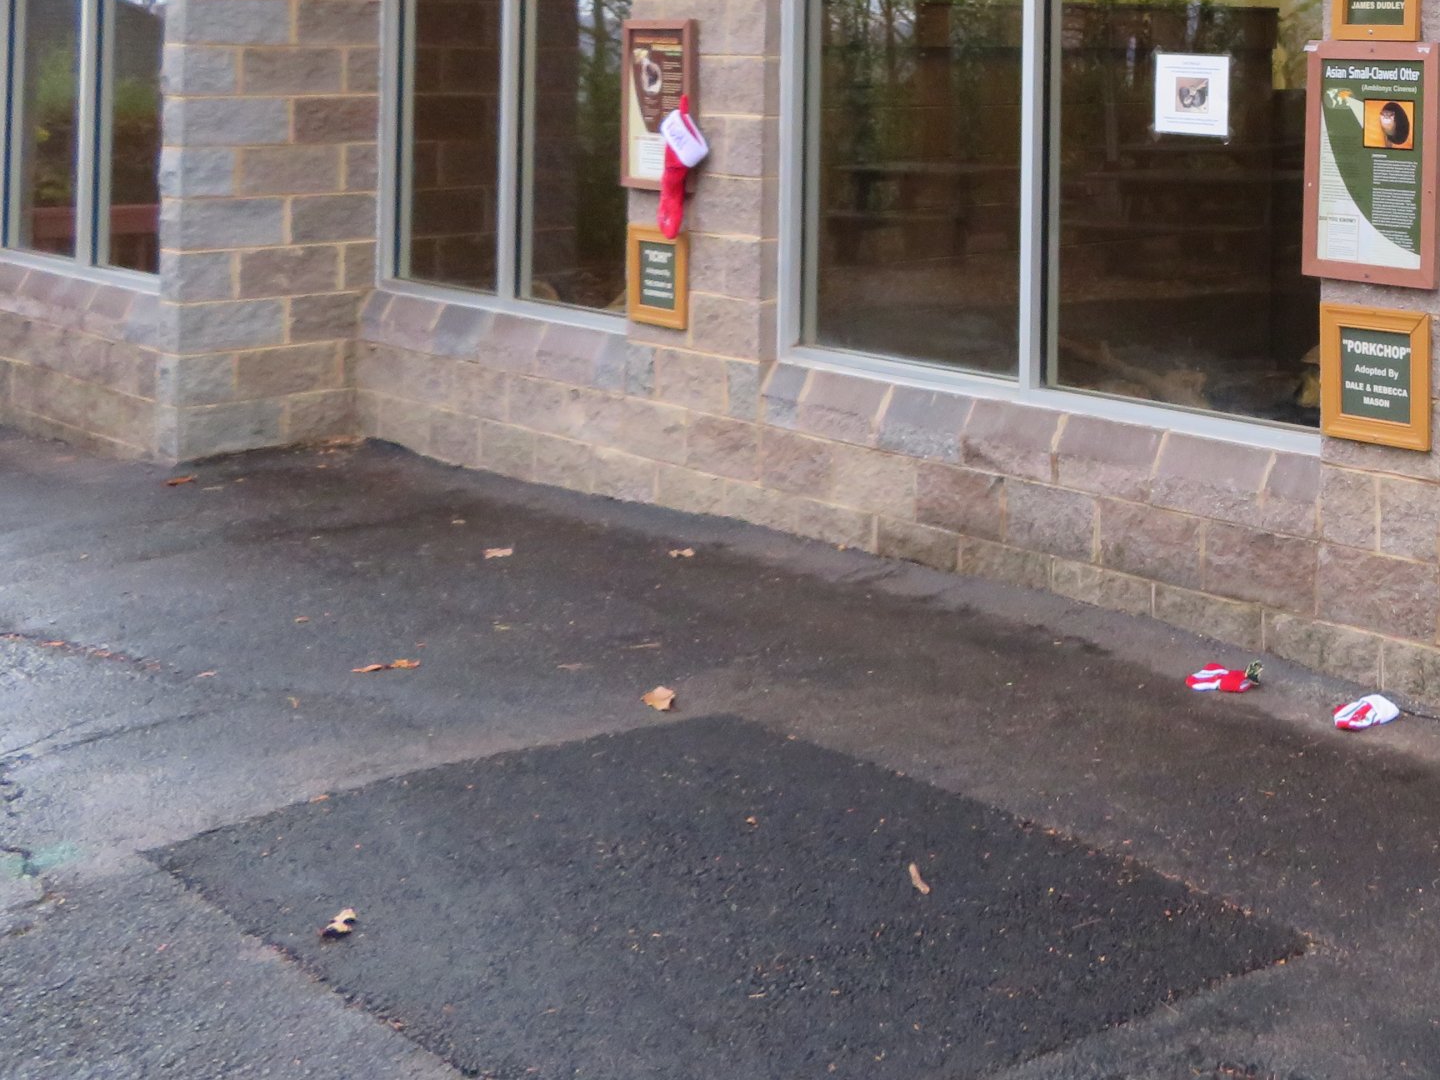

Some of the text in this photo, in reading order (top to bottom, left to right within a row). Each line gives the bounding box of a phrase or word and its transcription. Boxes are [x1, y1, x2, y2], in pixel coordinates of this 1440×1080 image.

[1351, 1, 1405, 9] JAMES DUDLEY
[1325, 65, 1420, 81] Asian Small-Clawed Otter
[1342, 339, 1411, 359] "PORKCHOP"
[1354, 364, 1399, 380] Adopted By
[1345, 381, 1408, 397] DALE & REBECCA
[1363, 396, 1390, 408] MASON
